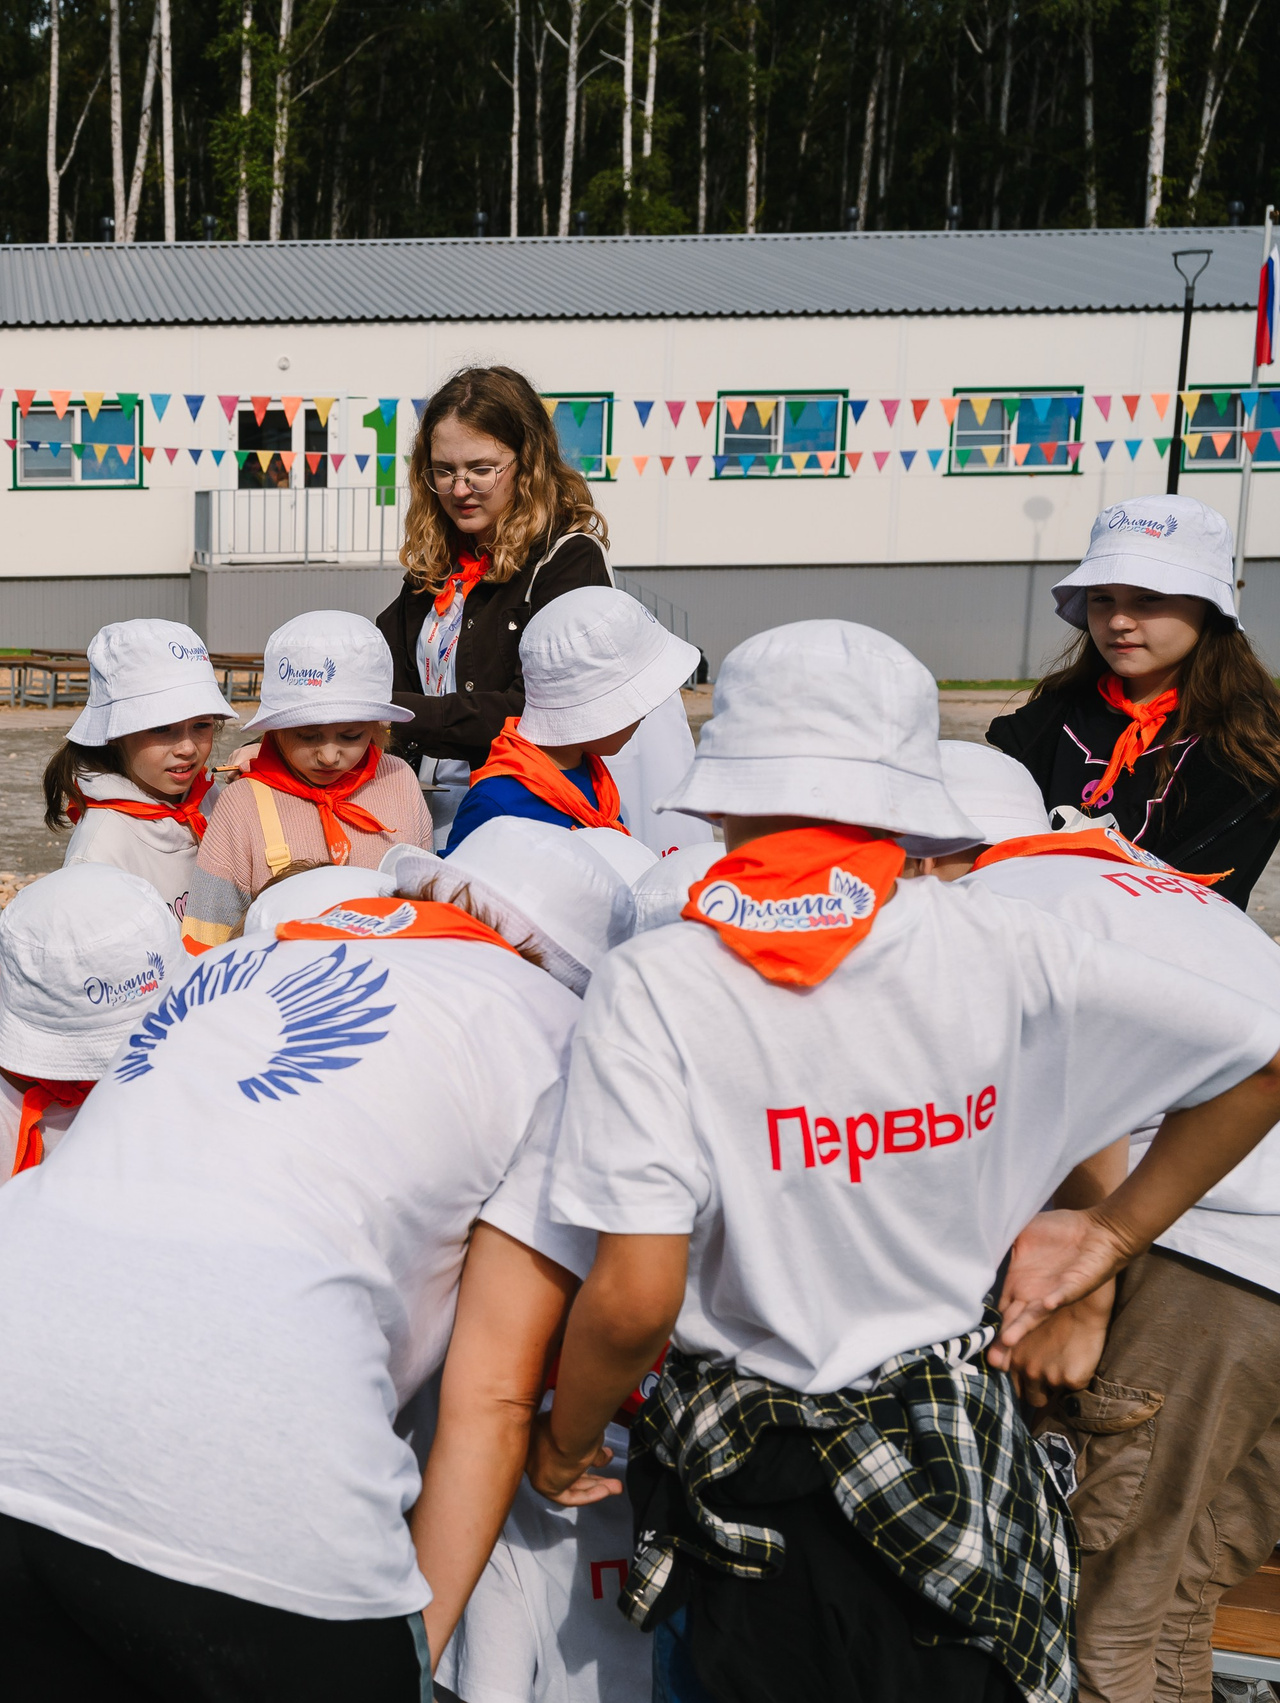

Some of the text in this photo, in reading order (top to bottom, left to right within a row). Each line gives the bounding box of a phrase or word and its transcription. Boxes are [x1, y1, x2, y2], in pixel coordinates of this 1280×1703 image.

[1108, 510, 1165, 531] Орлята
[278, 656, 324, 682] Орлята
[703, 884, 843, 927] Орлята
[84, 969, 156, 1005] Орлята
[766, 1084, 997, 1183] Первые
